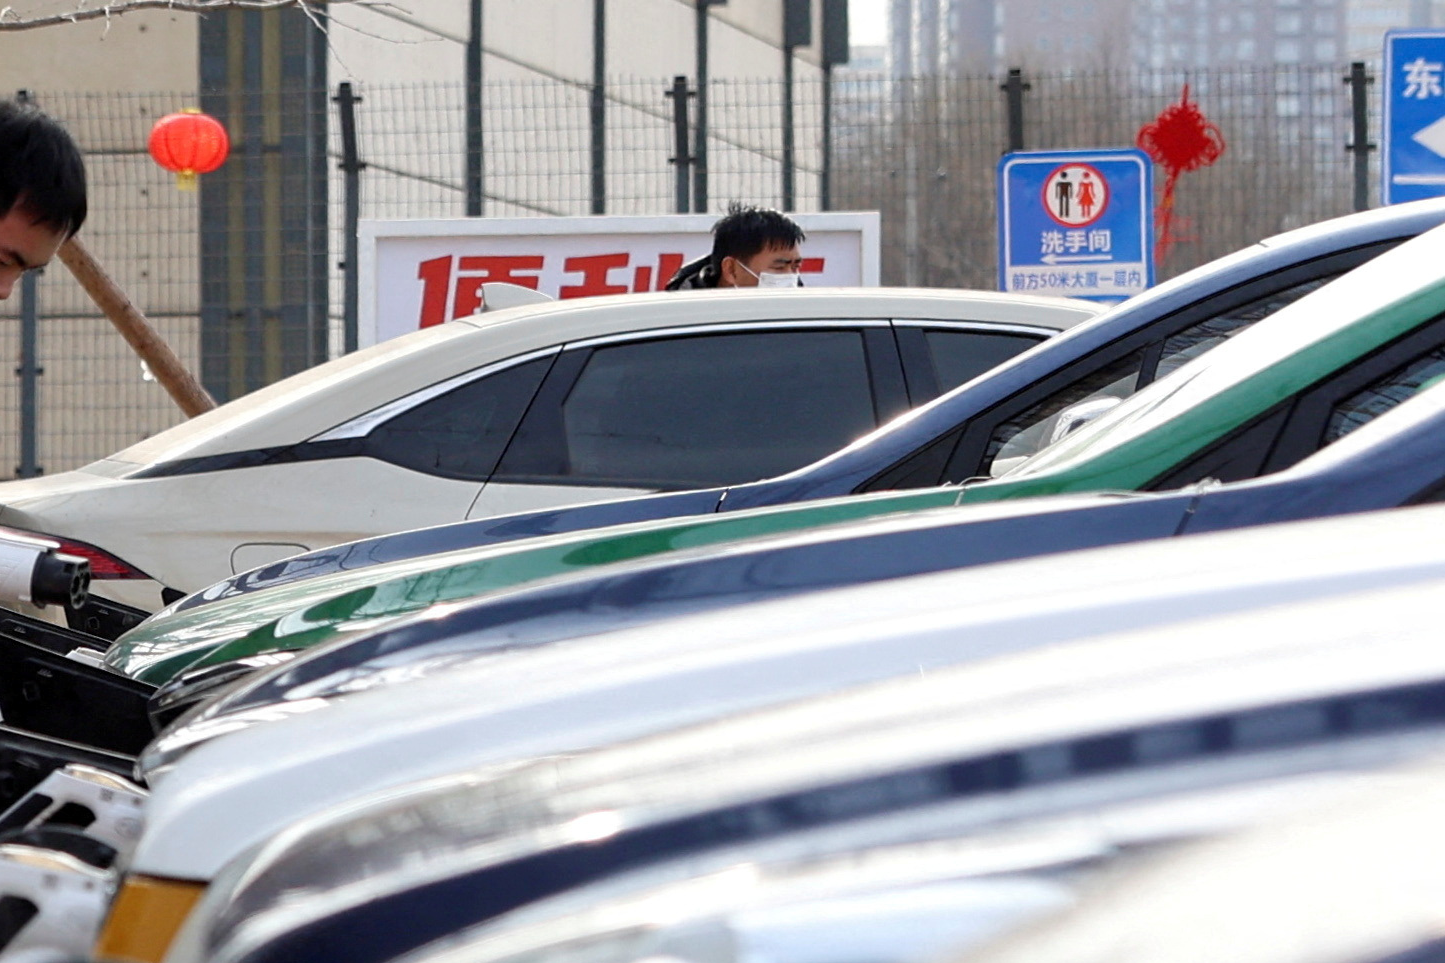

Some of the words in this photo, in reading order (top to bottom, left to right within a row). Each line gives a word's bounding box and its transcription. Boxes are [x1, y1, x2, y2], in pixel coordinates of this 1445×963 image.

[1402, 57, 1443, 99] 东
[1041, 229, 1112, 253] 洗手间
[1012, 270, 1141, 290] 前方50米大厦一层内
